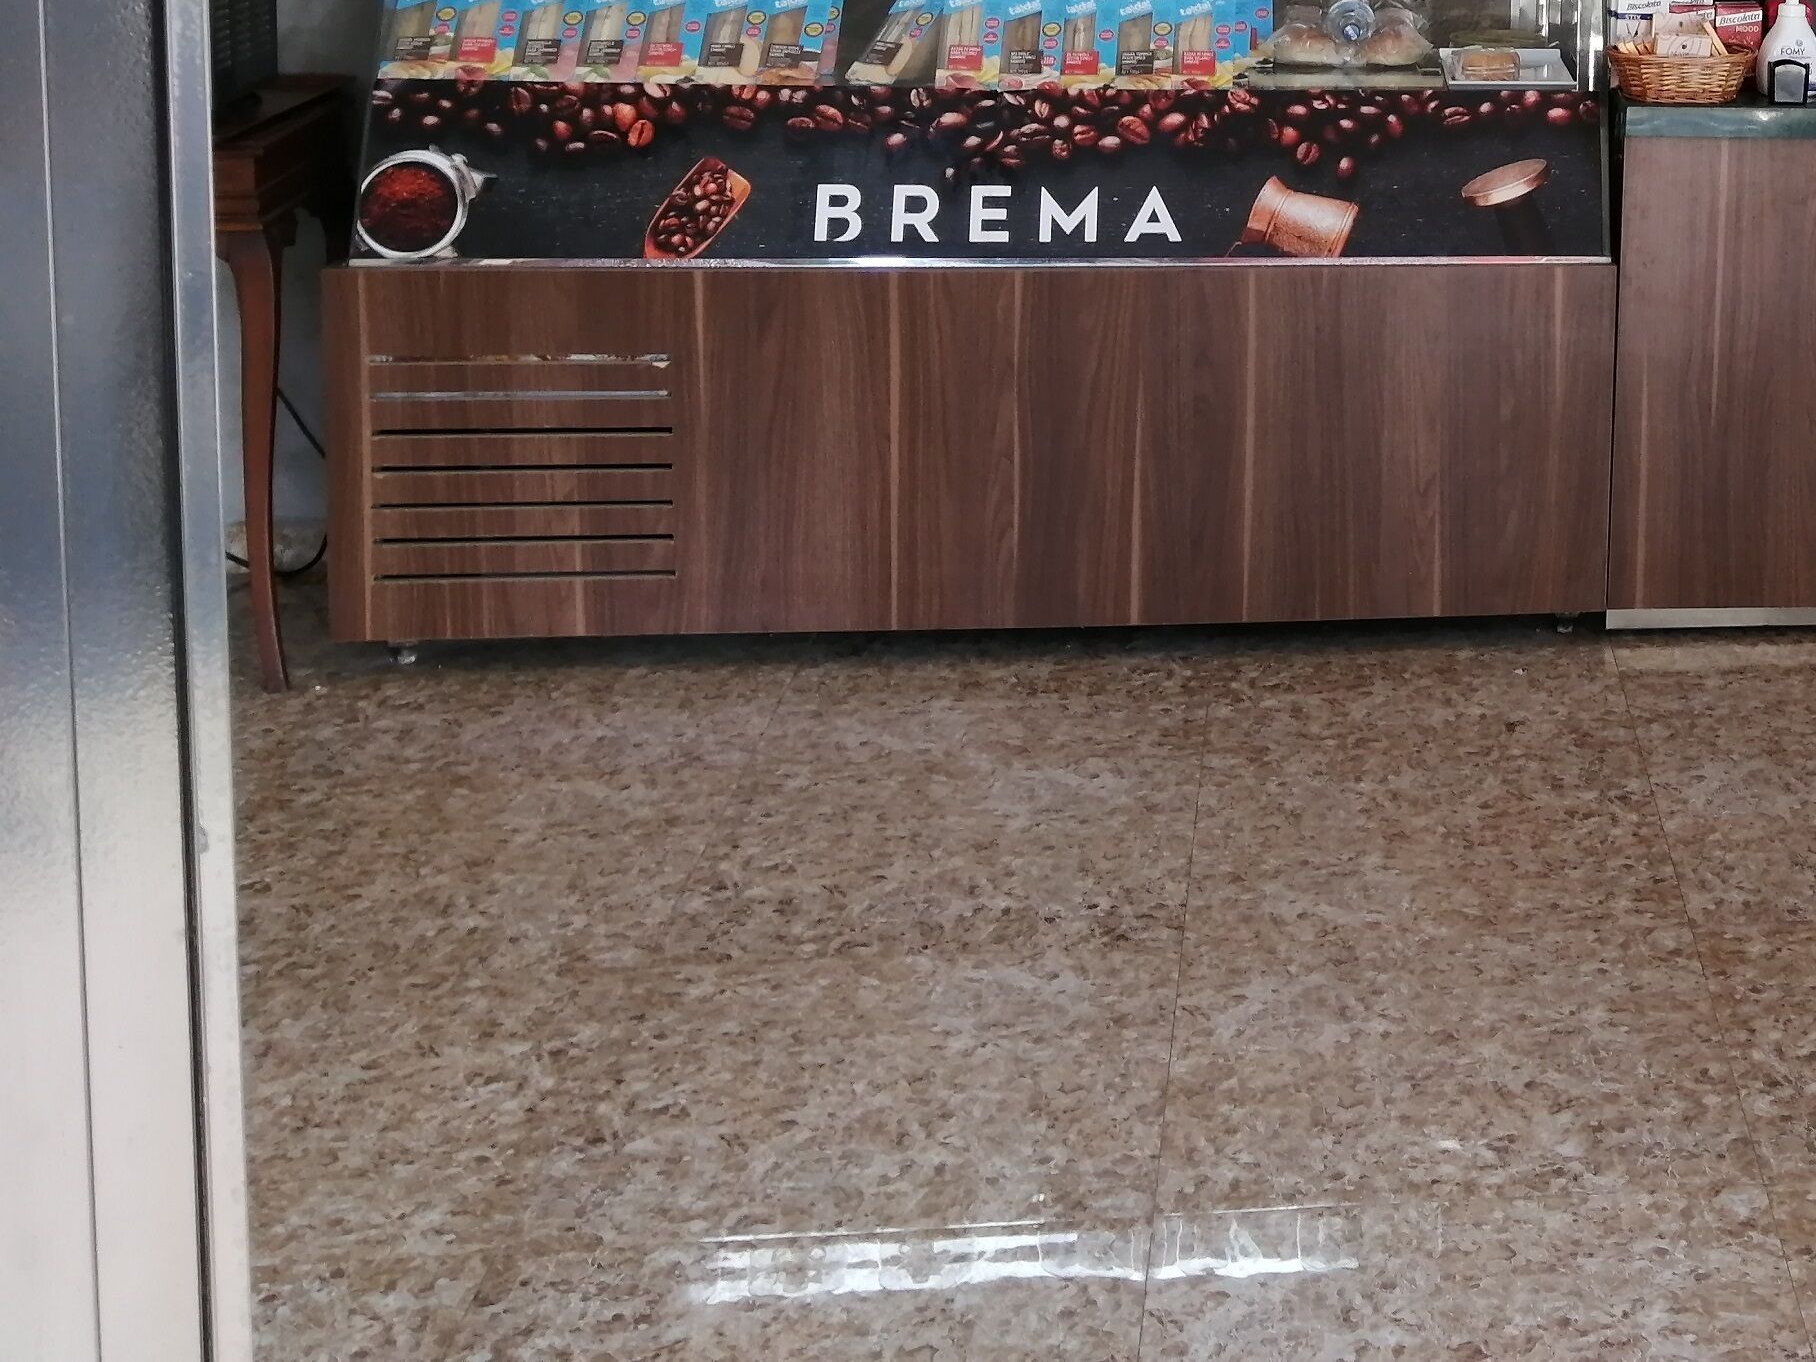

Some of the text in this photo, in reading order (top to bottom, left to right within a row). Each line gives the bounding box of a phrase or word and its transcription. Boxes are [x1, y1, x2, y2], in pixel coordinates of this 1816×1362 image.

[1718, 12, 1761, 25] Biscolata
[1780, 47, 1806, 56] FOMY
[813, 182, 1184, 244] BREMA
